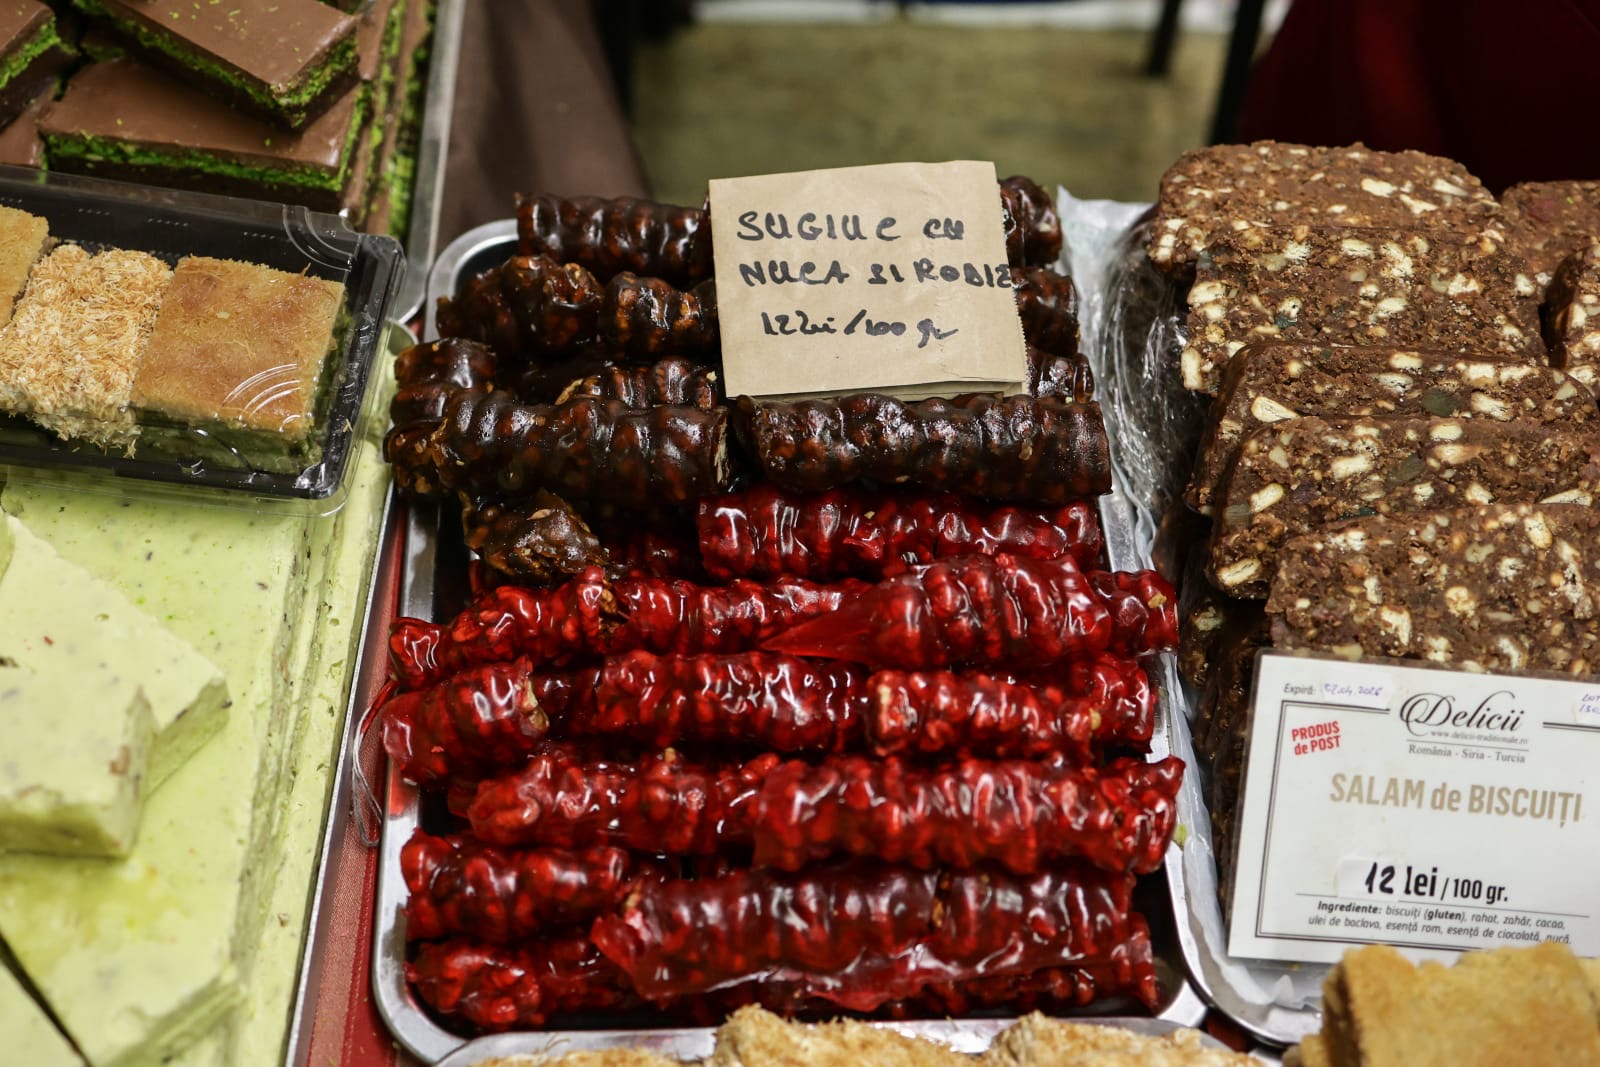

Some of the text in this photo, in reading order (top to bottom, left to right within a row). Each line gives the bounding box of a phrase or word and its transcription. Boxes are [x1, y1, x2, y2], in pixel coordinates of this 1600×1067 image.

[923, 218, 964, 240] CU
[739, 260, 850, 286] NUCA
[1399, 690, 1525, 737] Delicii
[1291, 721, 1340, 742] PRODUS
[1294, 735, 1341, 756] de POST
[1408, 744, 1453, 757] România
[1461, 748, 1486, 760] Siria
[1495, 751, 1526, 763] Turcia
[1330, 773, 1583, 829] SALAM de BISCUIȚI
[1365, 862, 1395, 894] 12
[1404, 866, 1438, 897] lei
[1486, 885, 1508, 905] gr.
[1308, 915, 1326, 926] ulei
[1328, 916, 1341, 927] de
[1344, 917, 1382, 930] baclava,
[1482, 928, 1494, 938] de
[1318, 900, 1383, 914] Ingrediente:
[1471, 913, 1500, 924] rahat,
[1503, 915, 1532, 927] zahăr,
[1535, 919, 1566, 930] cacao,
